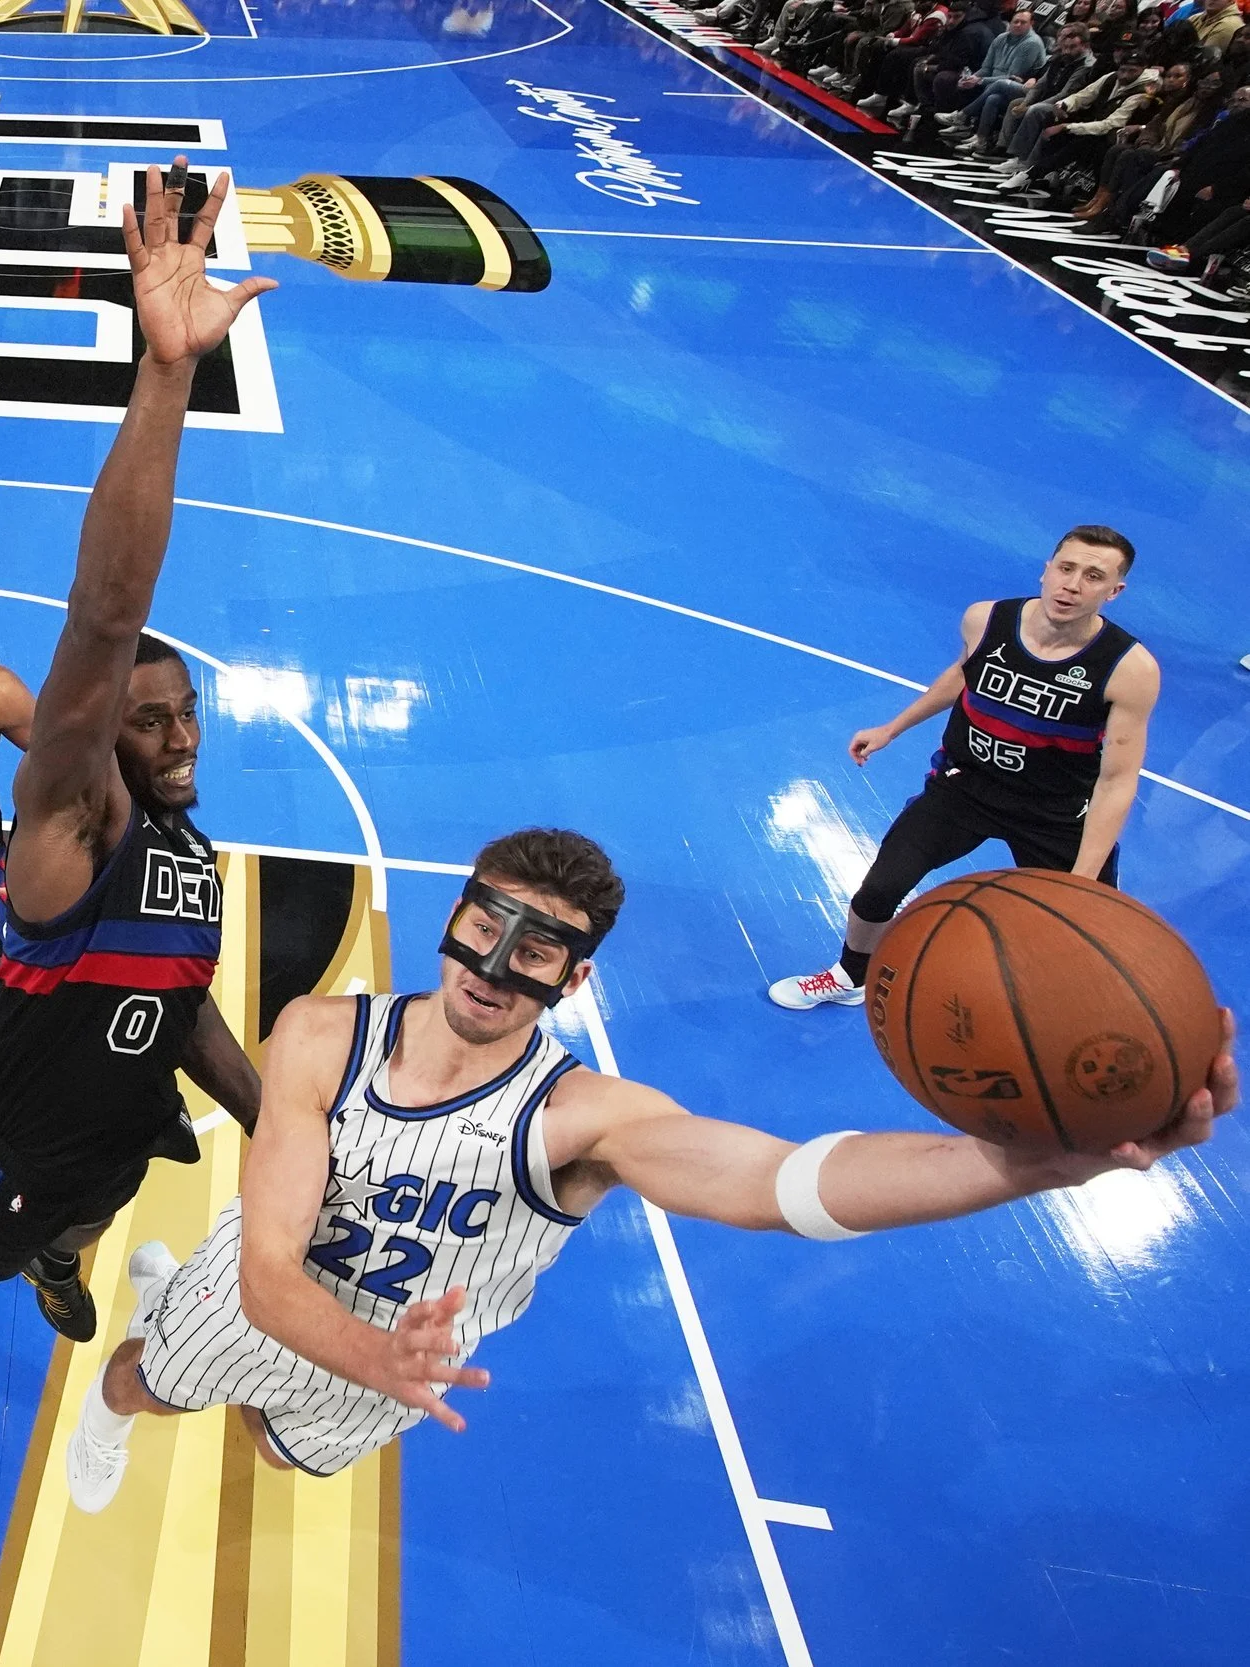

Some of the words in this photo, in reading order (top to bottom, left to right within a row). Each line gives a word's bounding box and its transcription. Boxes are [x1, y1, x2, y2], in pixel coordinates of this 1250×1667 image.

[976, 662, 1082, 721] DET
[1056, 674, 1091, 688] StockX
[968, 725, 1026, 773] 55
[106, 994, 164, 1055] 0
[457, 1116, 507, 1147] Disney
[307, 1214, 433, 1304] 22
